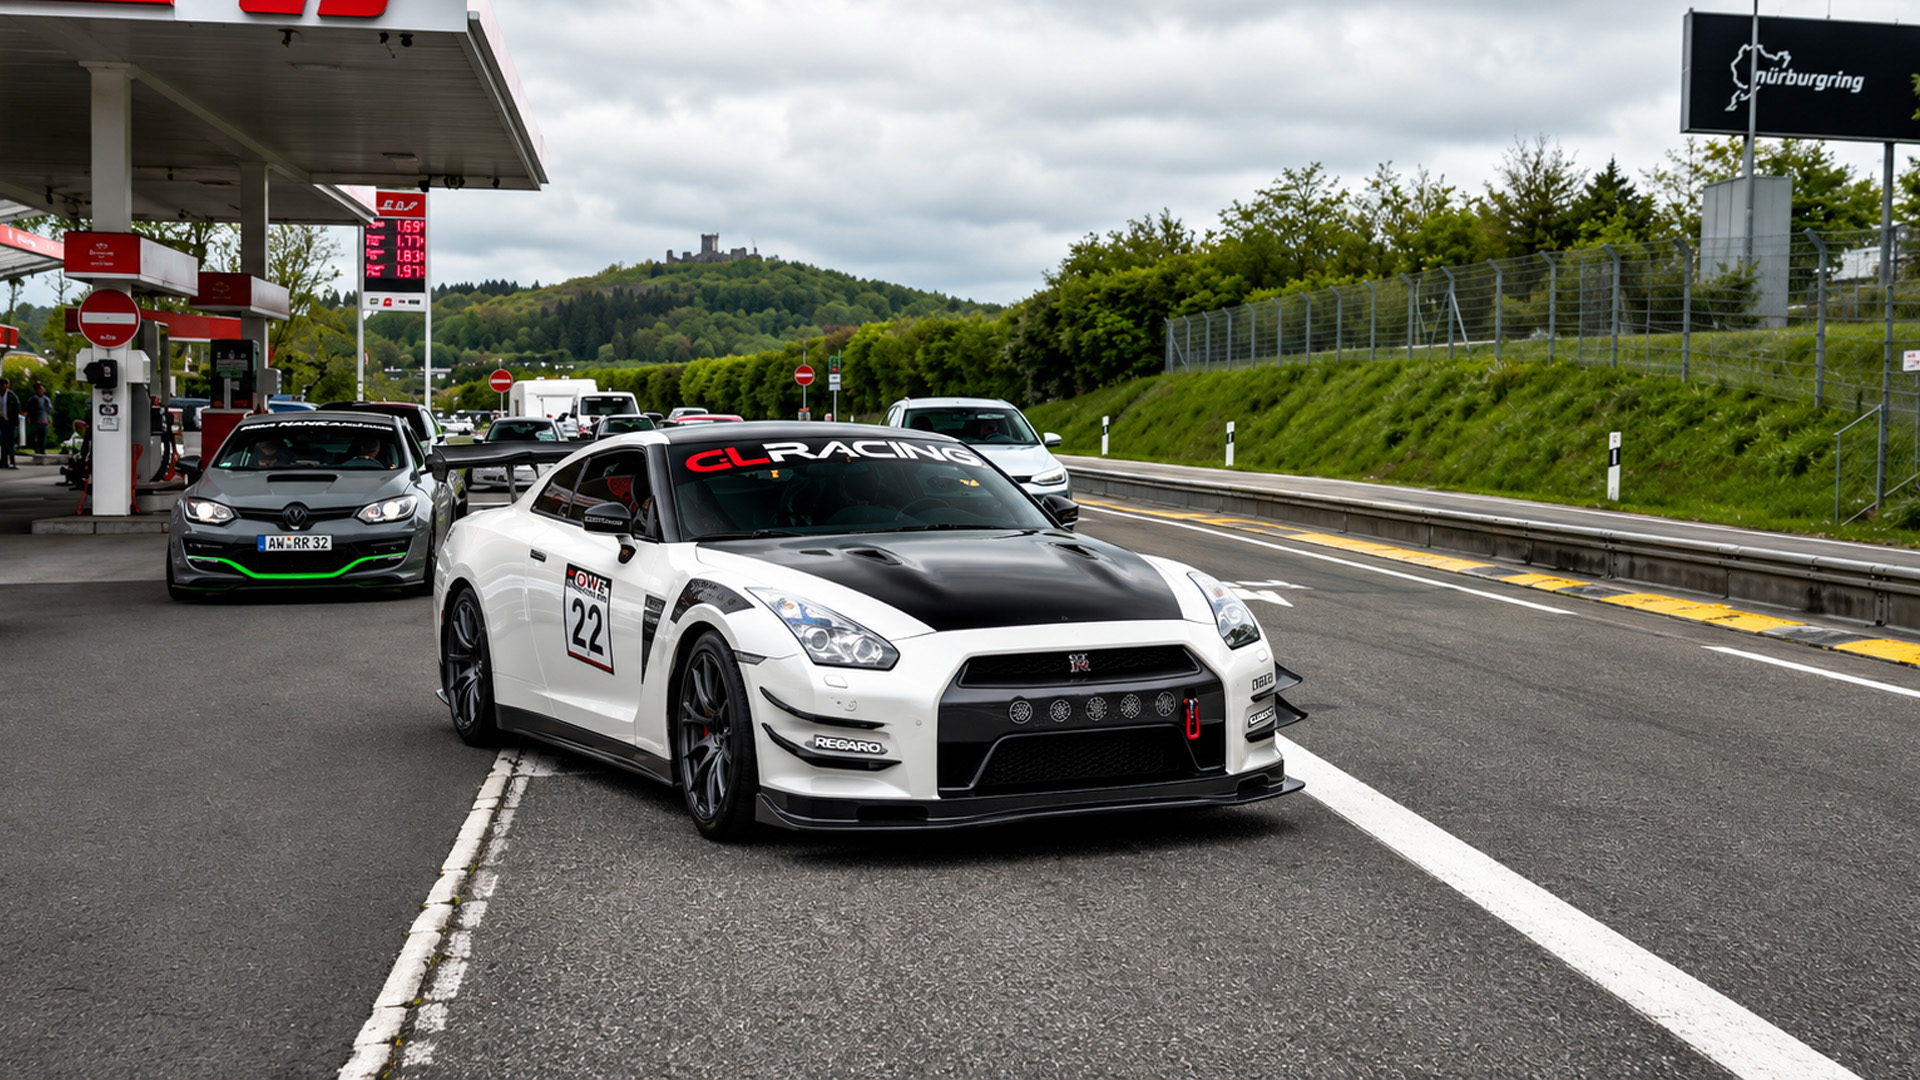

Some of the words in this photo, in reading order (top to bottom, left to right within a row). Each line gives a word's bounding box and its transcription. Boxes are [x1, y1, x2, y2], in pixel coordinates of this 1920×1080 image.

[1755, 67, 1864, 93] nürburgring
[293, 537, 310, 549] RR
[313, 537, 328, 549] 32
[572, 598, 604, 656] 22
